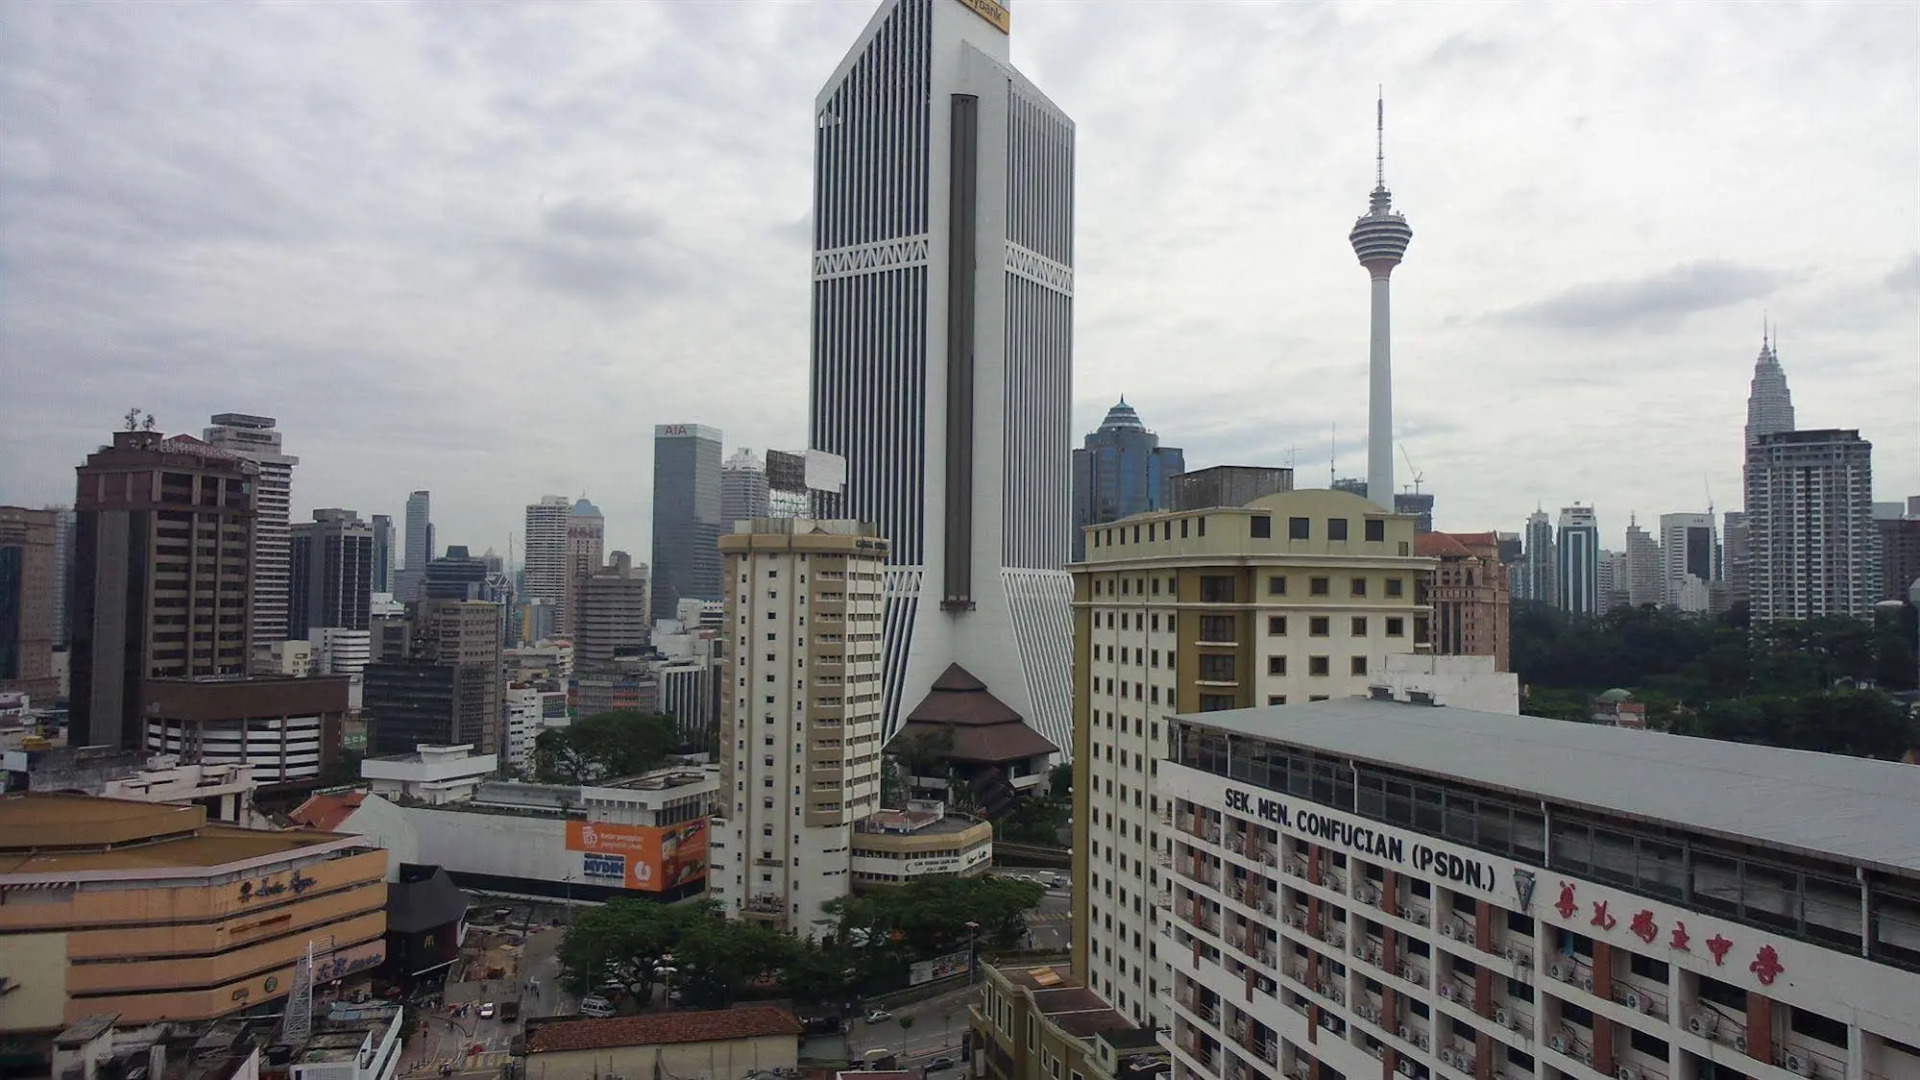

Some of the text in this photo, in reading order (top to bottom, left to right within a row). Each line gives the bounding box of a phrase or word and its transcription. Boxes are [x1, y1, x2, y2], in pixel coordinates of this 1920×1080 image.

[664, 424, 687, 436] AIA
[1224, 788, 1495, 892] SEK. MEN. CONFUCIAN (PSDN.)
[584, 859, 624, 874] MYDIN
